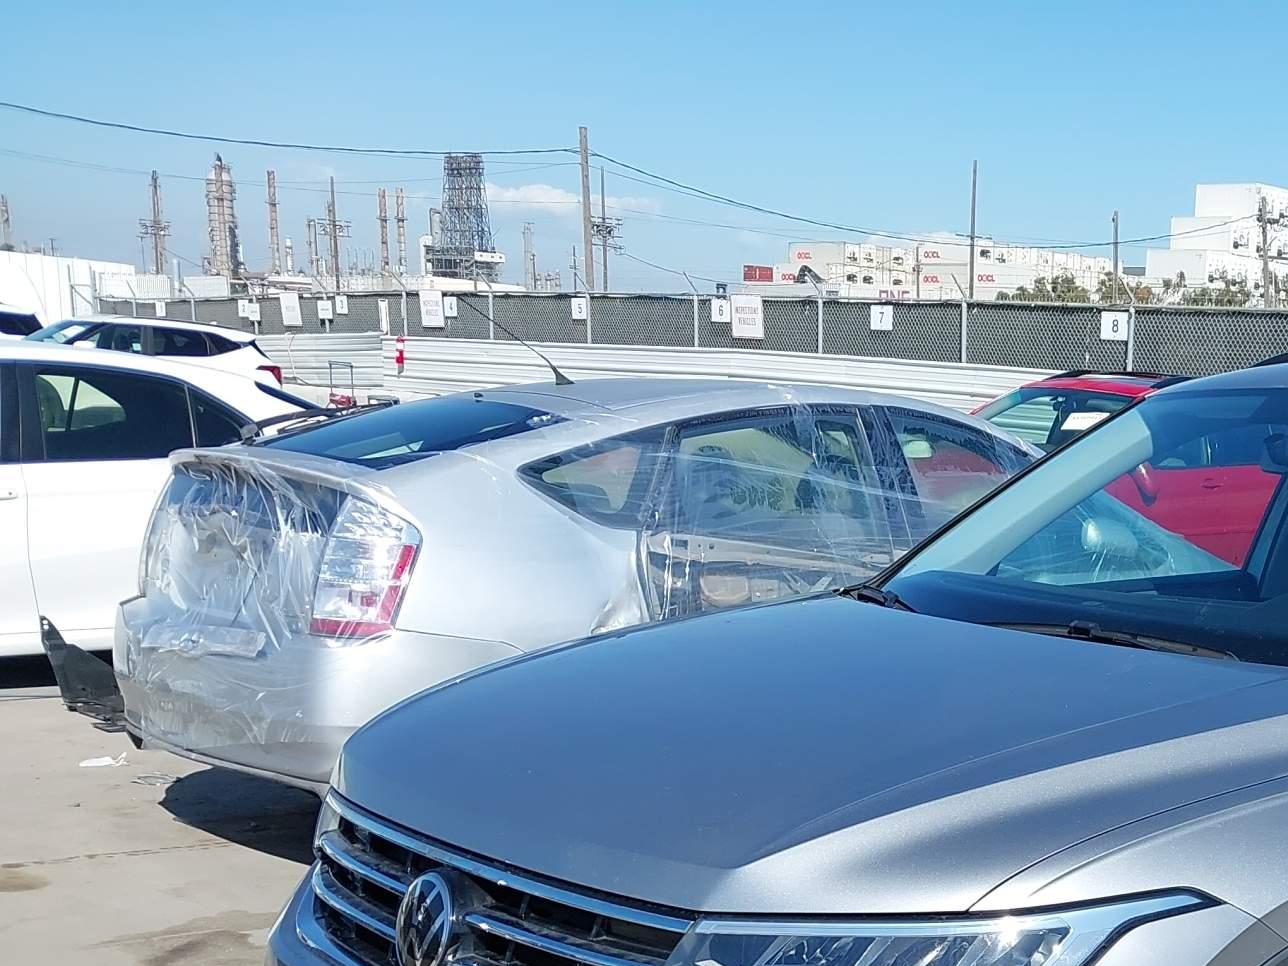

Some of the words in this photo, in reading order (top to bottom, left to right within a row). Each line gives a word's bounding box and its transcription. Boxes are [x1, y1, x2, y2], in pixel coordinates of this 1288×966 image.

[923, 250, 940, 259] OOCL
[923, 275, 940, 284] OOCL
[977, 273, 996, 283] OOCL
[577, 303, 583, 314] 5
[718, 304, 724, 317] 6
[879, 311, 885, 324] 7
[1111, 318, 1119, 334] 8
